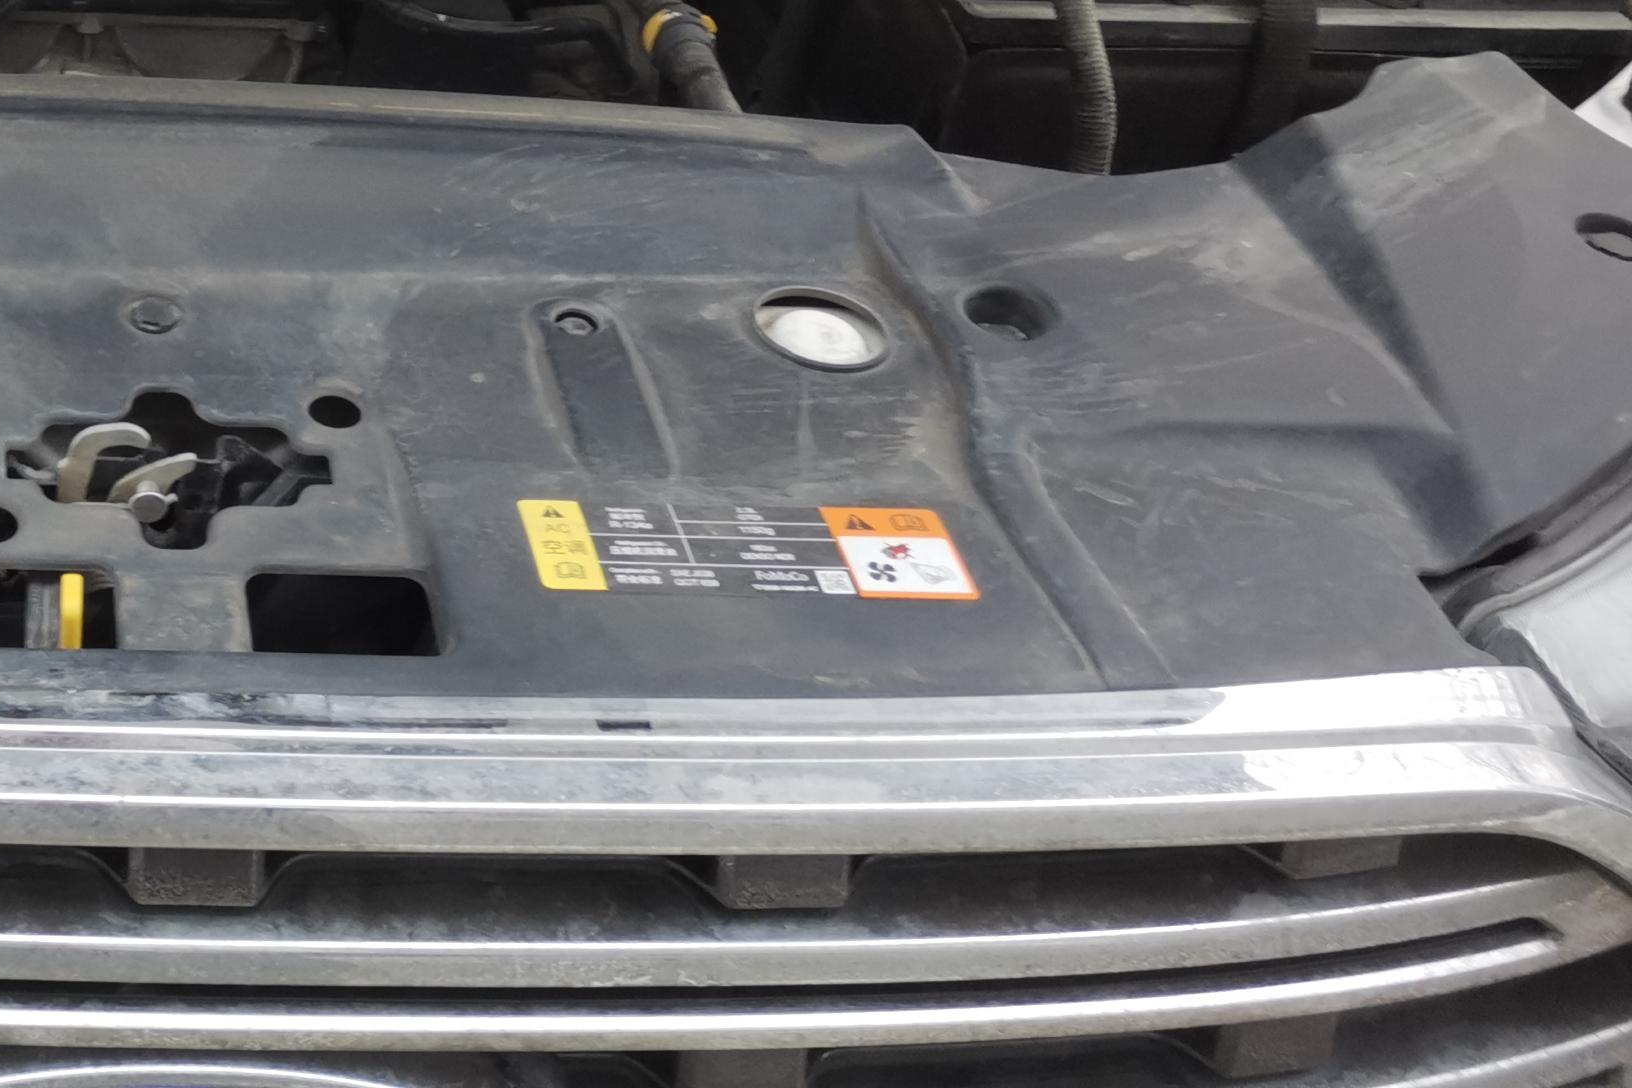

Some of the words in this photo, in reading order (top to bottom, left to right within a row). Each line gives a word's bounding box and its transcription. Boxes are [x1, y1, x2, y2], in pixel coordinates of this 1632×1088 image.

[545, 523, 571, 534] AC
[542, 540, 589, 555] 空调
[754, 571, 810, 582] FoMoCo
